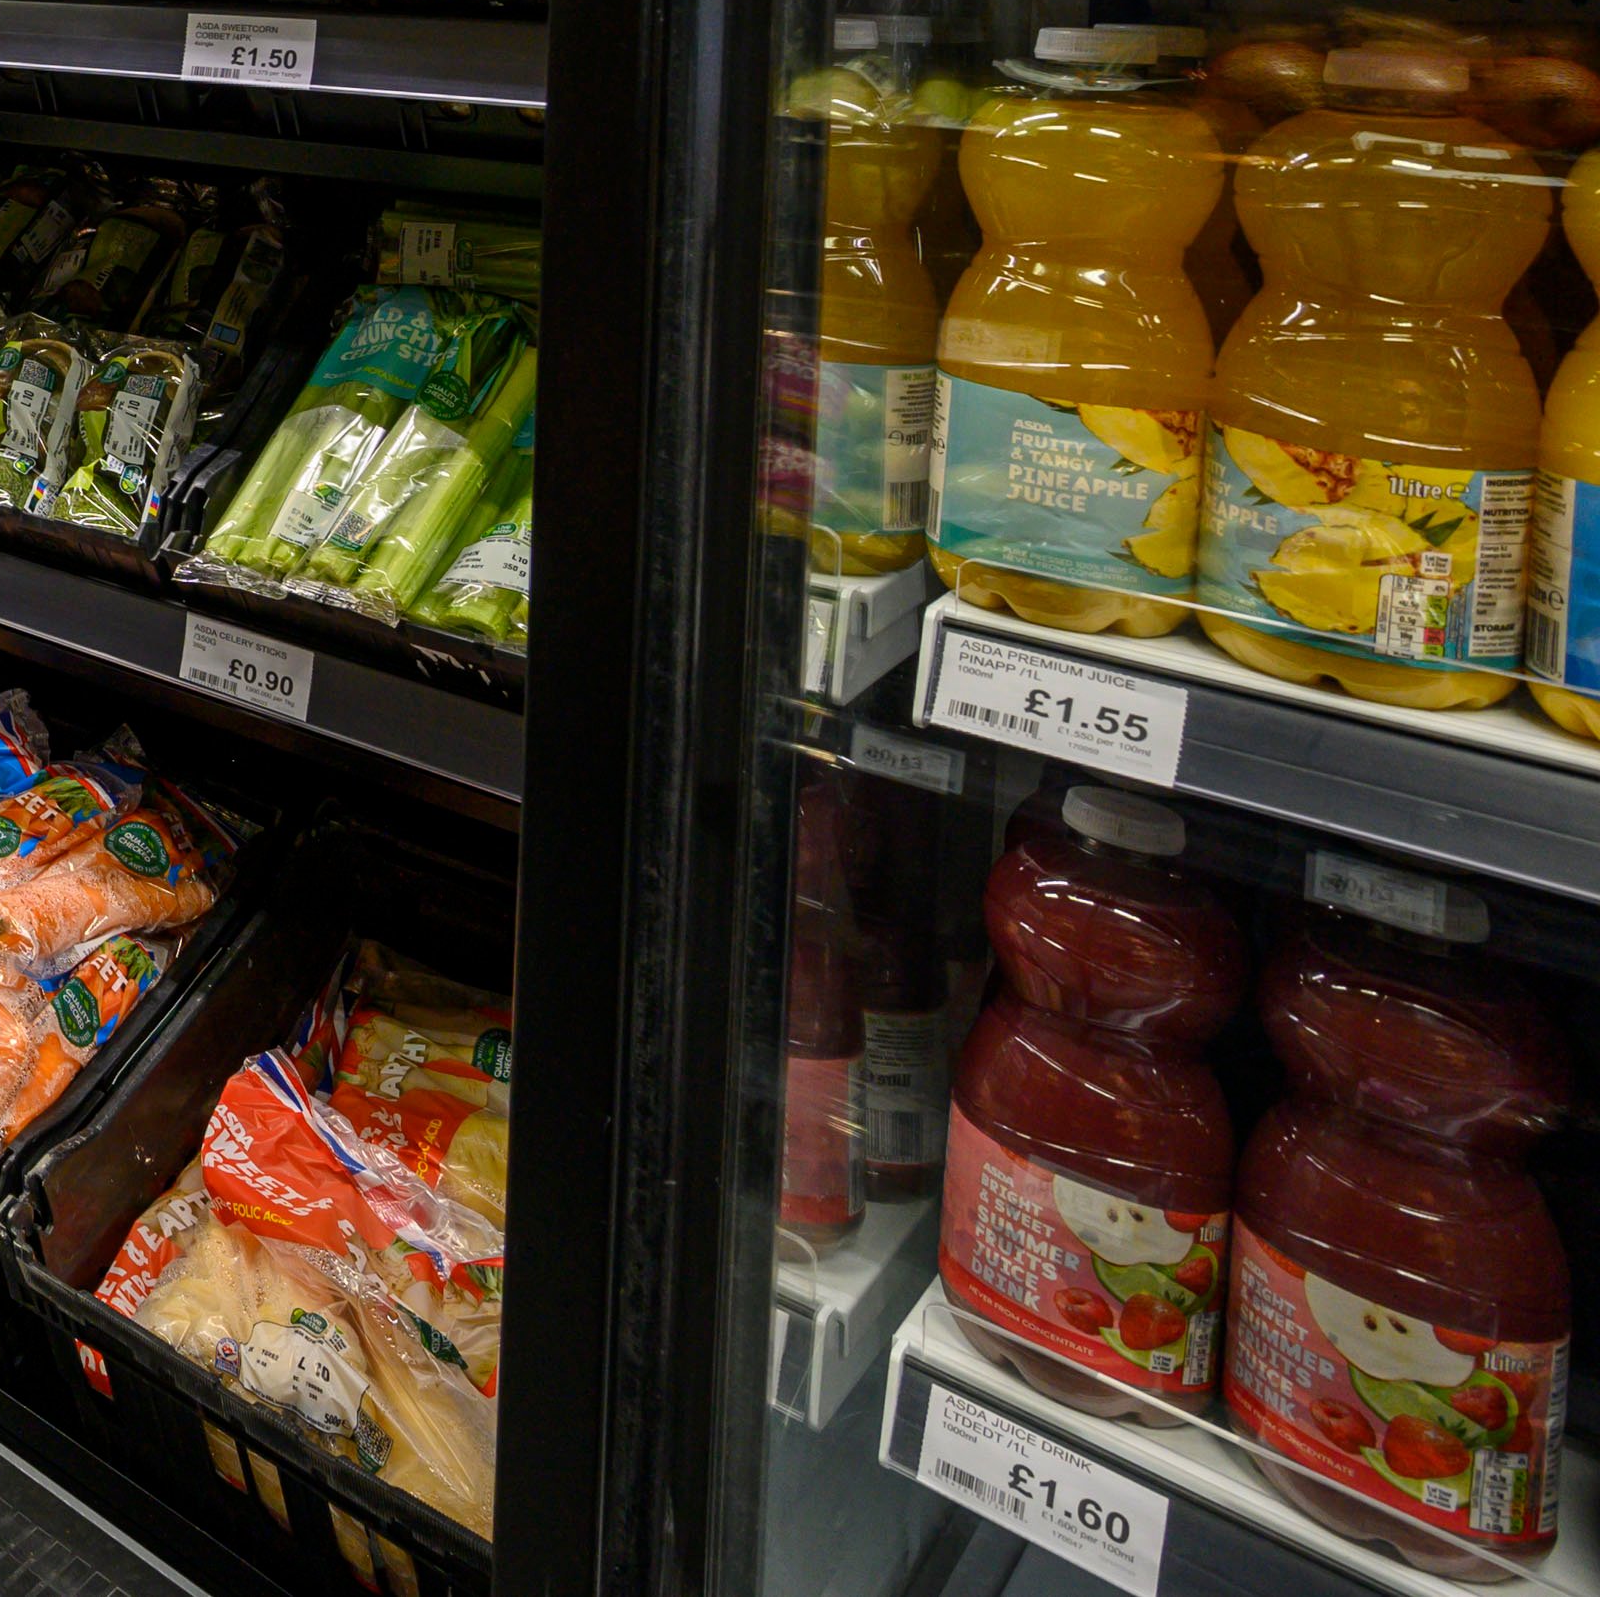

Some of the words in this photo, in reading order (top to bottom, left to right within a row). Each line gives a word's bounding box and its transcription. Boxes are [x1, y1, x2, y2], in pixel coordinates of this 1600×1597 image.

[195, 32, 230, 40] COBBET
[196, 22, 219, 30] ASDA
[222, 24, 278, 33] SWEETCORN
[231, 46, 297, 69] £1.50
[1011, 431, 1087, 455] FRUITY
[1013, 419, 1054, 434] ASDA
[1011, 447, 1023, 460] &
[1028, 448, 1095, 473] TANGY
[1005, 483, 1087, 513] JUICE
[1008, 464, 1148, 500] PINEAPPLE
[194, 624, 217, 637] ASDA
[219, 631, 254, 648] CELERY
[255, 644, 287, 659] STICKS
[228, 659, 293, 696] £0.90
[958, 665, 994, 680] 1000ml
[959, 652, 1016, 672] PINAPP
[1019, 667, 1042, 681] /1L
[960, 639, 1003, 658] ASDA
[1007, 650, 1084, 677] PREMIUM
[1087, 669, 1137, 690] JUICE
[1024, 689, 1149, 743] £1.55
[1096, 738, 1114, 748] per
[215, 1104, 254, 1151] ASDA
[982, 1162, 1014, 1188] ASDA
[981, 1172, 1043, 1216] BRIGHT
[233, 1204, 261, 1221] FOLIC
[263, 1211, 293, 1226] ACID
[979, 1190, 989, 1203] &
[994, 1195, 1055, 1238] SWEET
[975, 1223, 1058, 1281] FRUITS
[976, 1204, 1080, 1271] SUMMER
[973, 1241, 1040, 1291] JUICE
[970, 1257, 1040, 1312] DRINK
[1021, 1319, 1095, 1357] CONCENTRATE
[942, 1421, 978, 1444] 1000ml
[944, 1407, 1003, 1443] LTDEDT
[1006, 1439, 1029, 1458] /1L
[945, 1395, 987, 1422] ASDA
[992, 1416, 1036, 1446] JUICE
[1041, 1442, 1092, 1474] DRINK
[1008, 1463, 1130, 1545] £1.60
[1079, 1532, 1098, 1545] per
[1101, 1541, 1135, 1564] 100ml
